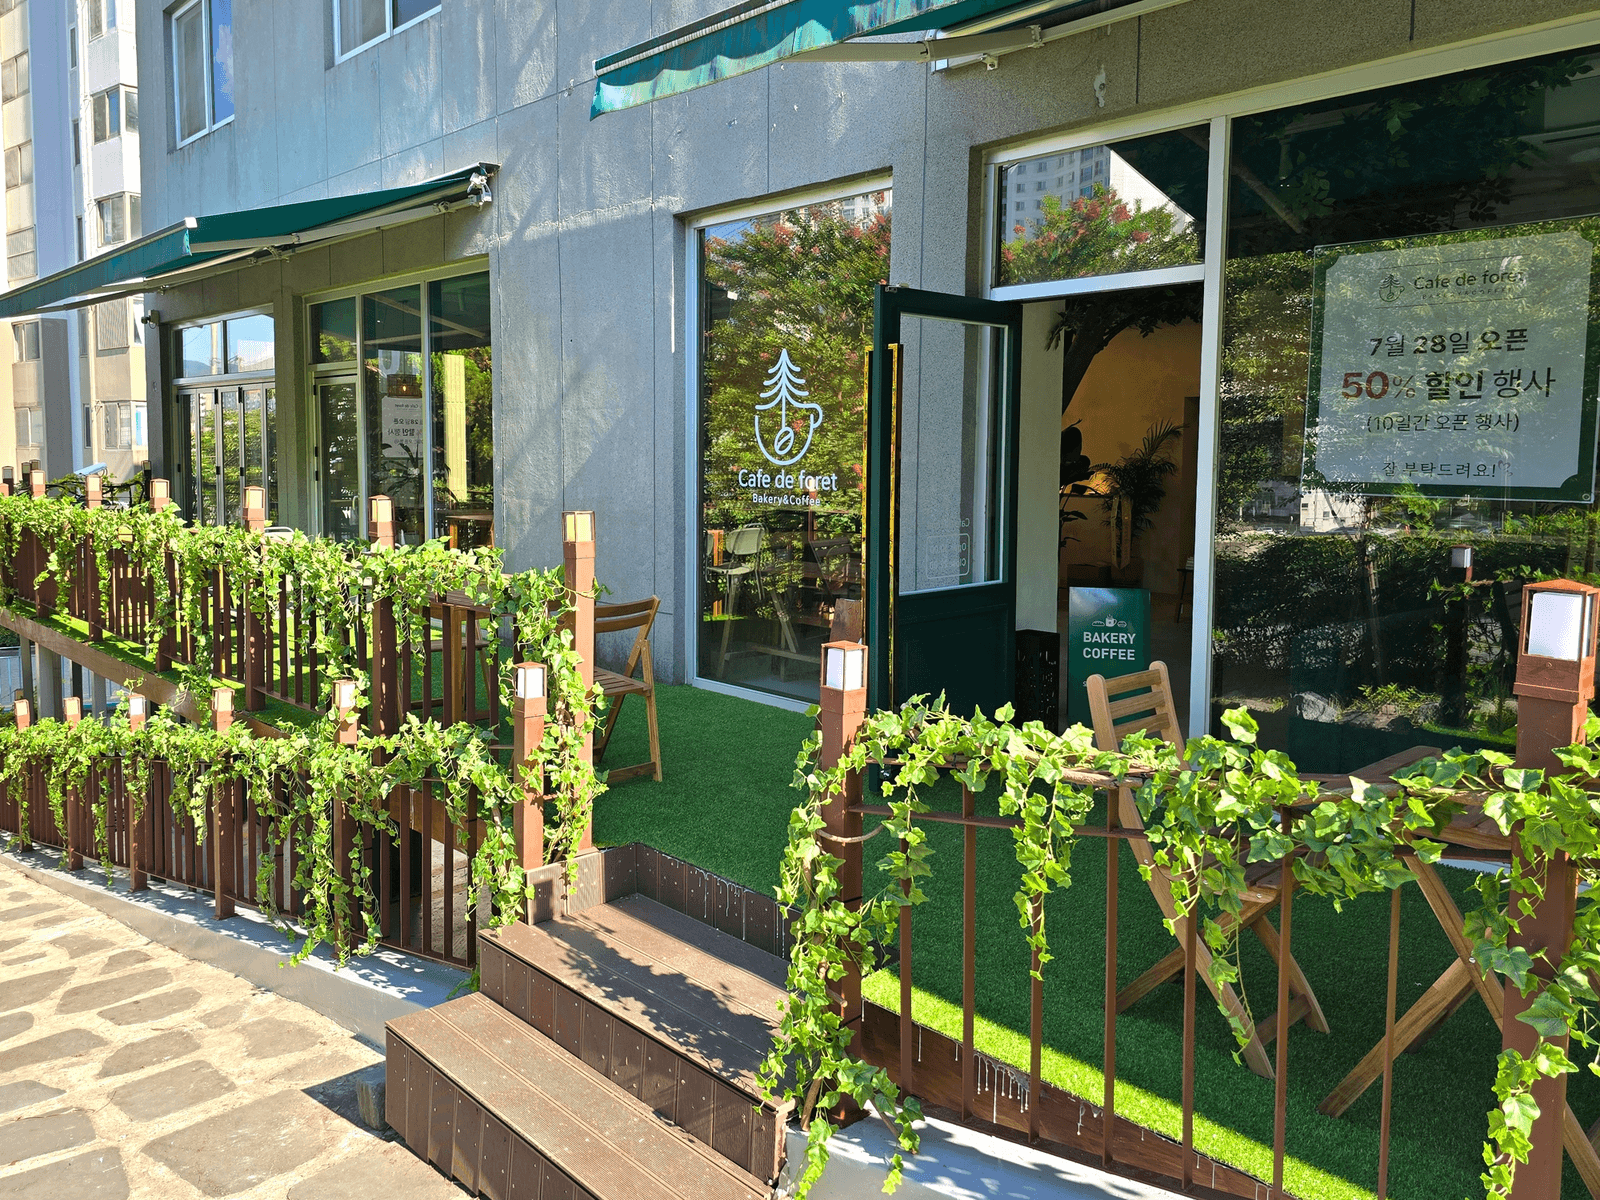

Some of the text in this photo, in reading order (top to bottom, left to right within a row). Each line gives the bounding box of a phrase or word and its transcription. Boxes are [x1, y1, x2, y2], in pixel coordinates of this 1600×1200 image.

[1414, 274, 1449, 289] Cafe
[1455, 272, 1477, 286] de
[1370, 328, 1529, 357] 7월 28일 오픈
[1341, 367, 1557, 401] 50% 할인 행사
[1366, 413, 1520, 433] (10일간 오픈 행사)
[1382, 461, 1496, 478] 잘 부탁드려요!
[738, 468, 838, 491] Cafe de foret
[752, 493, 821, 506] Bakery&Coffee
[1083, 631, 1136, 645] BAKERY
[1082, 647, 1136, 661] COFFEE
